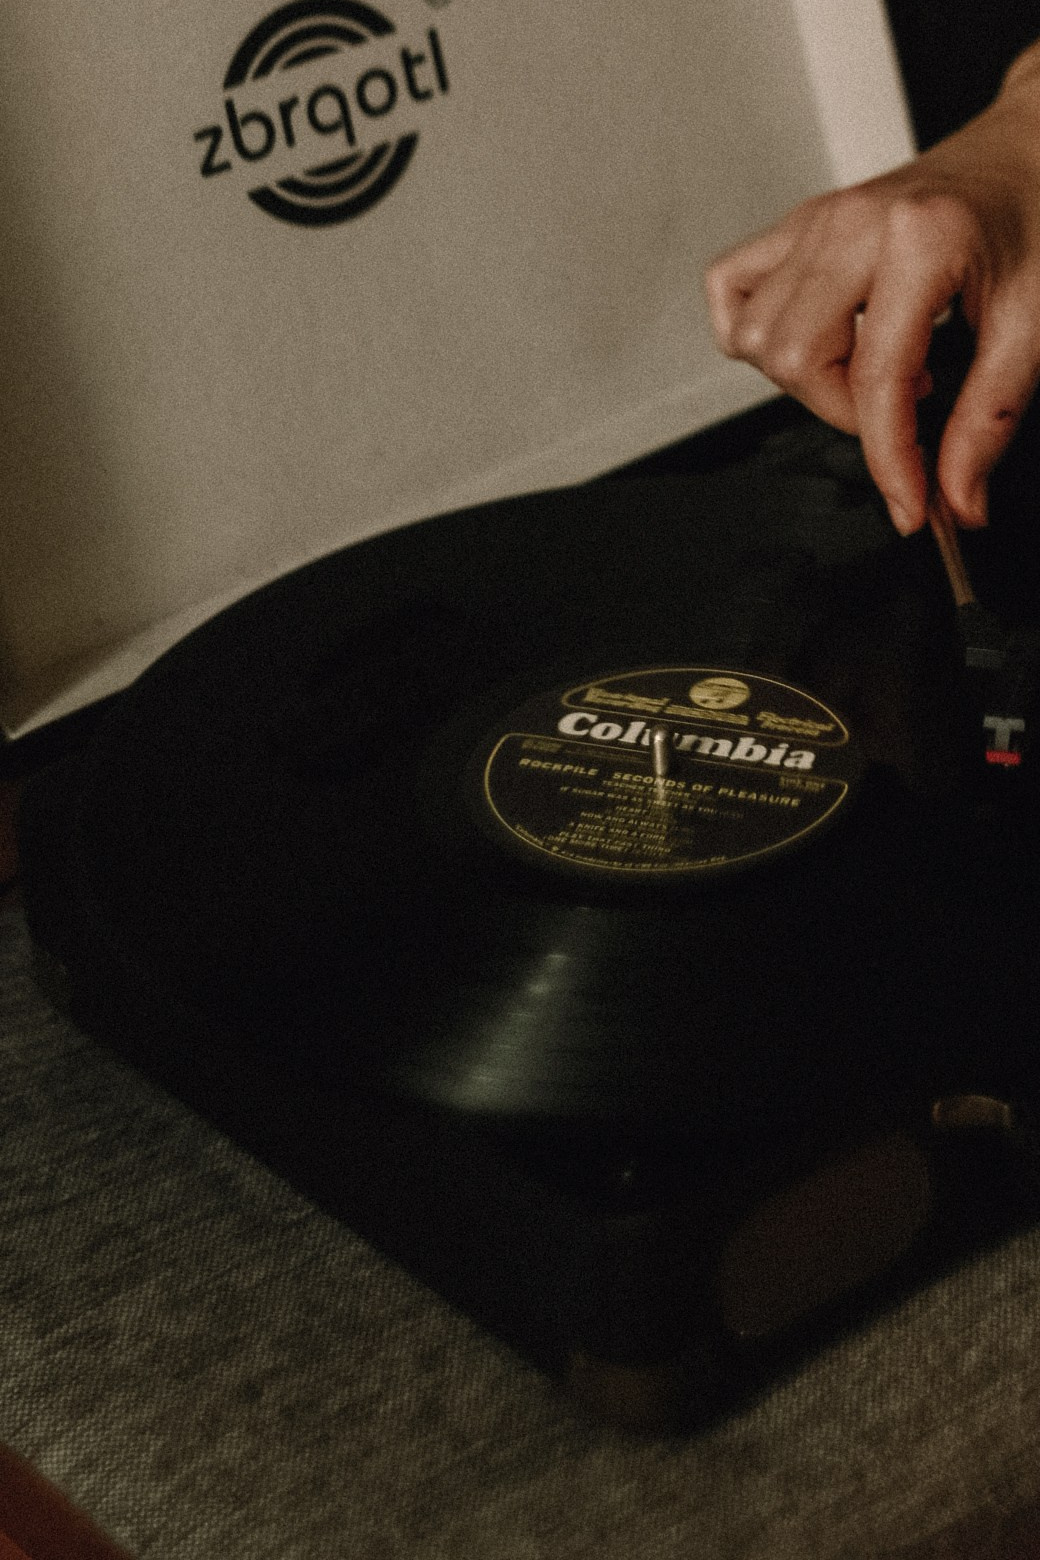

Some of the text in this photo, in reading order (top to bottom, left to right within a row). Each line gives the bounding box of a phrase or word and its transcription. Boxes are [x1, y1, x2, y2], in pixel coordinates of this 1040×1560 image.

[193, 27, 448, 178] zbrqotl
[518, 757, 599, 777] ROCKPILE
[691, 782, 714, 794] OF
[717, 786, 802, 808] PLEASURE
